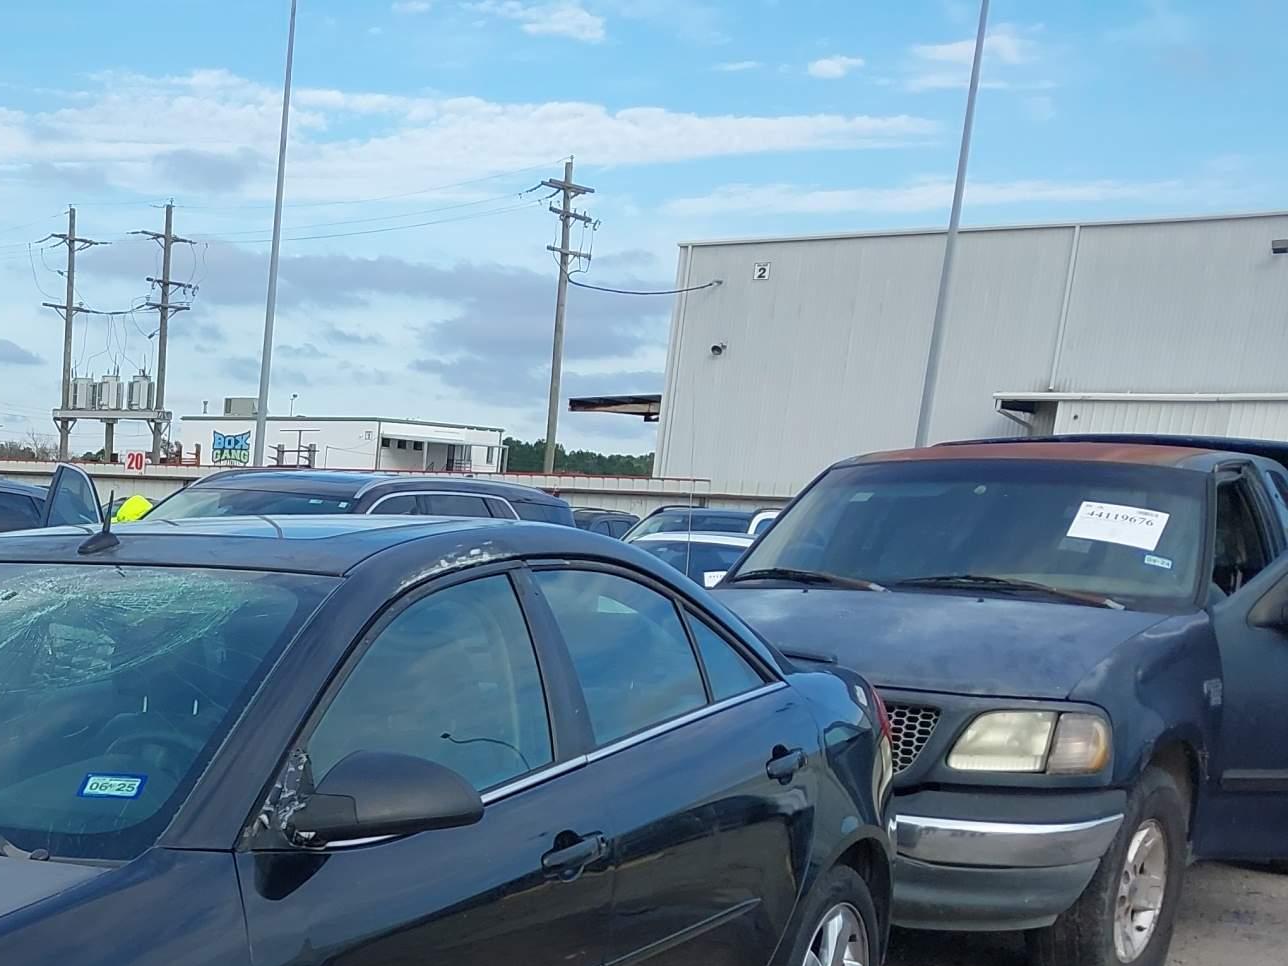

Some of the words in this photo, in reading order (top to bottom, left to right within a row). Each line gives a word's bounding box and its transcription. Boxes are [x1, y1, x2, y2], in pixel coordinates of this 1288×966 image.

[757, 267, 767, 279] 2
[213, 430, 251, 449] BOX
[127, 452, 144, 470] 20
[212, 449, 249, 463] GANG
[1087, 510, 1155, 527] 44119676
